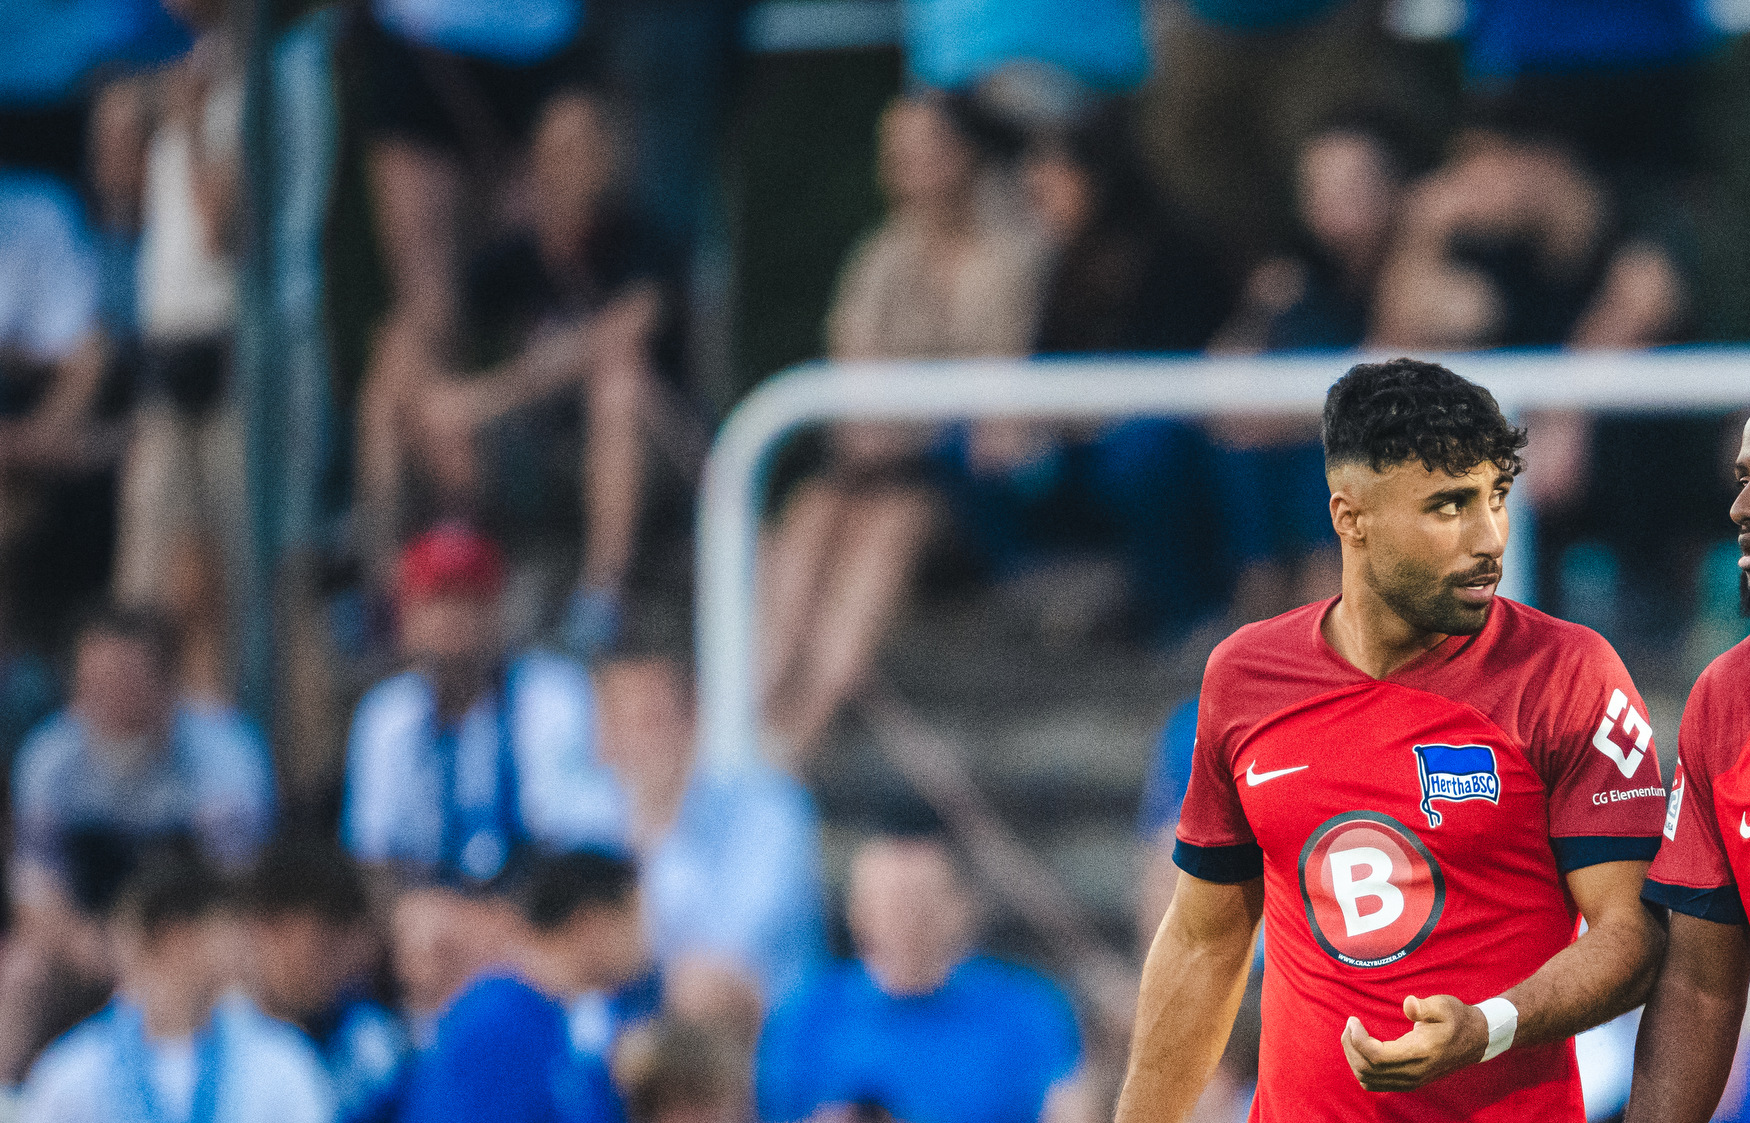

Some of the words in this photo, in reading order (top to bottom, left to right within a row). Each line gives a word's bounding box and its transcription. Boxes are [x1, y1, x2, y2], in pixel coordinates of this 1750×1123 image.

[1592, 792, 1609, 806] CG
[1609, 785, 1666, 802] Elementum
[1328, 846, 1405, 938] B
[1337, 949, 1407, 967] WWW.CRAZYBUZZER.DE
